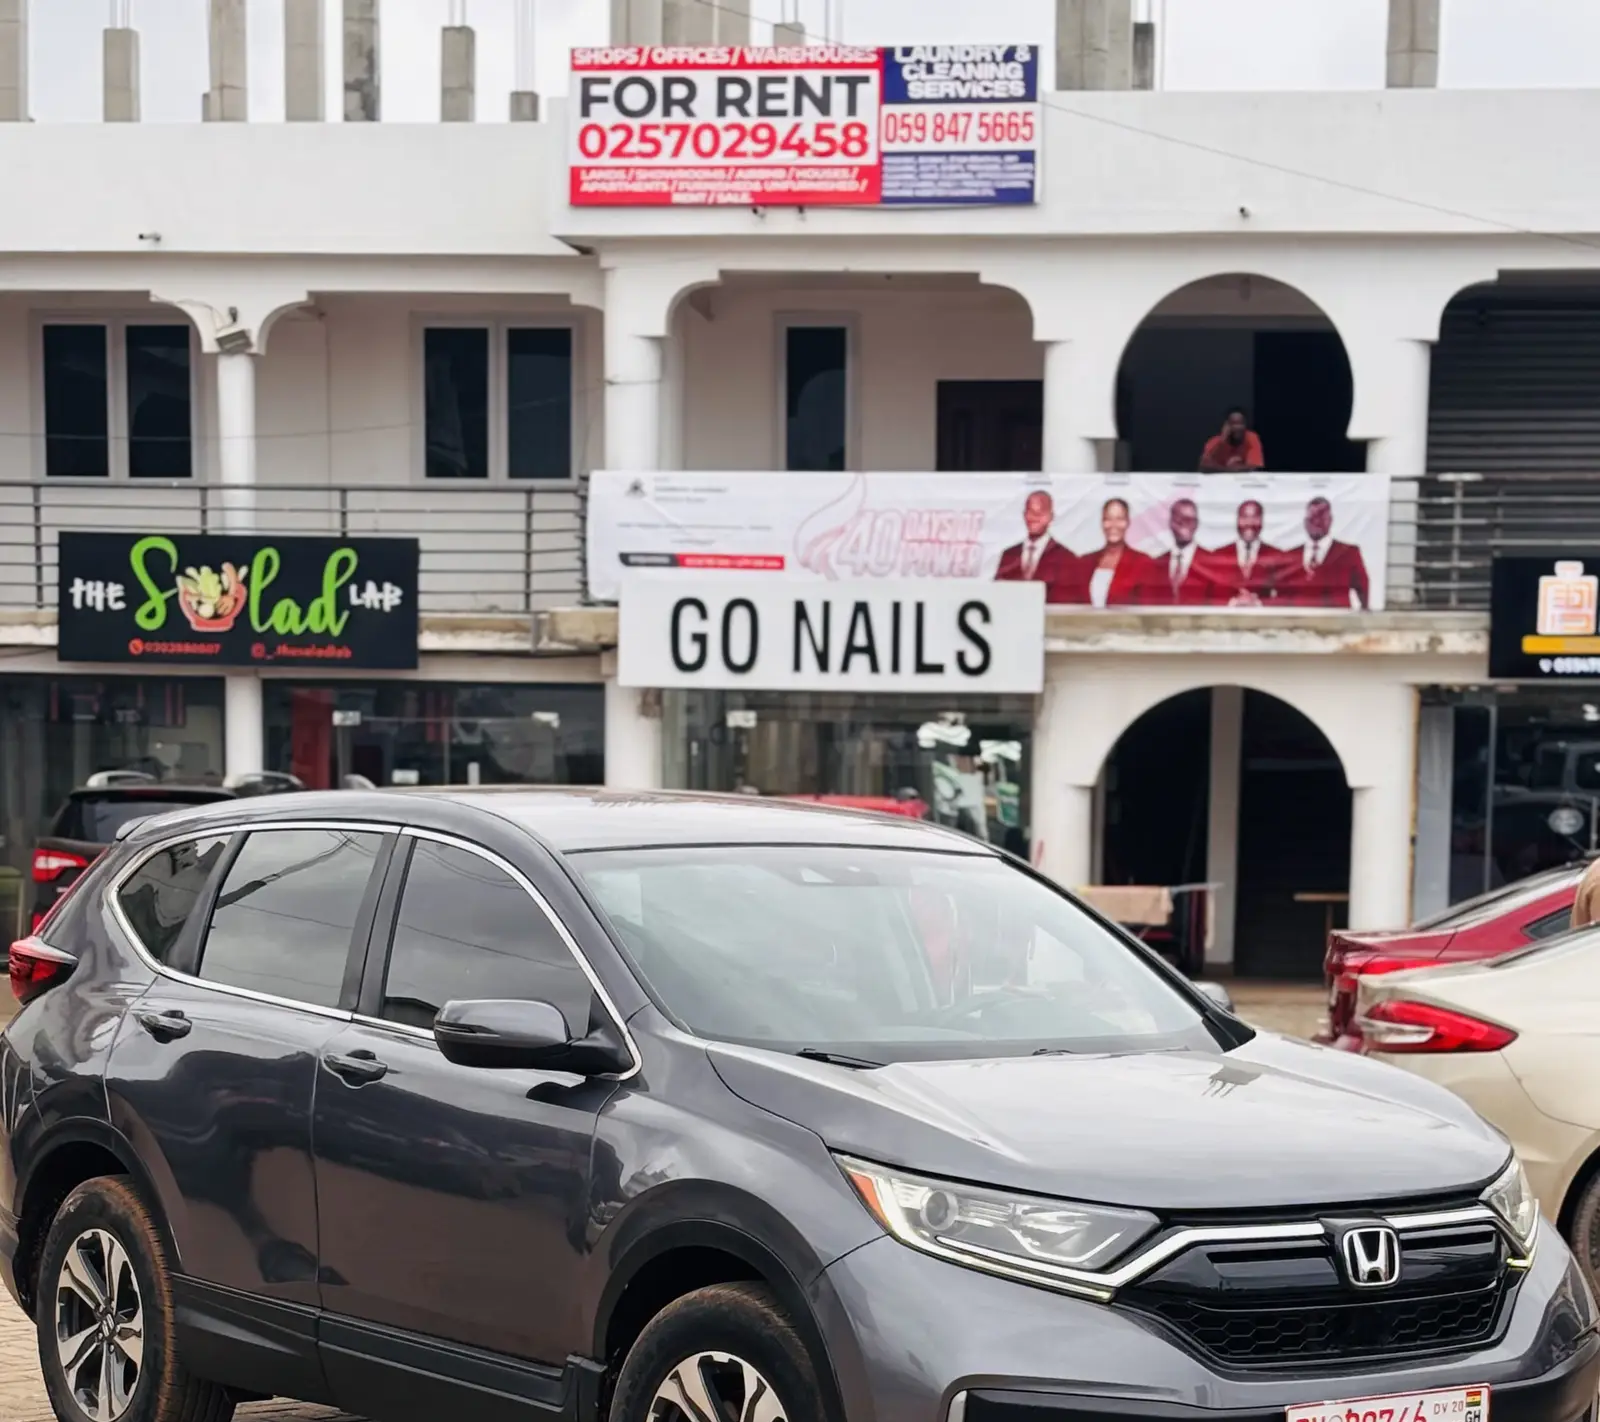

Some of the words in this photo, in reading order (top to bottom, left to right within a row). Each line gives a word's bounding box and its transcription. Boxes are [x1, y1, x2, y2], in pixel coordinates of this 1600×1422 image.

[573, 47, 640, 66] SHOPS
[651, 47, 731, 65] OFFICES
[743, 46, 879, 64] WAREHOUSES
[894, 45, 1006, 62] LAUNDRY
[1014, 45, 1032, 63] &
[901, 61, 1024, 81] CLEANING
[580, 76, 698, 118] FOR
[717, 76, 870, 118] RENT
[907, 80, 1026, 99] SERVICES
[885, 112, 926, 143] 059
[933, 112, 973, 143] 847
[978, 111, 1034, 142] 5665
[578, 122, 869, 159] 0257029458
[68, 577, 126, 611] THE
[130, 536, 358, 637] Slad
[349, 580, 403, 612] LAB
[670, 597, 759, 675] GO
[793, 599, 992, 677] NAILS
[1433, 1402, 1448, 1415] DV
[1452, 1400, 1464, 1413] 20
